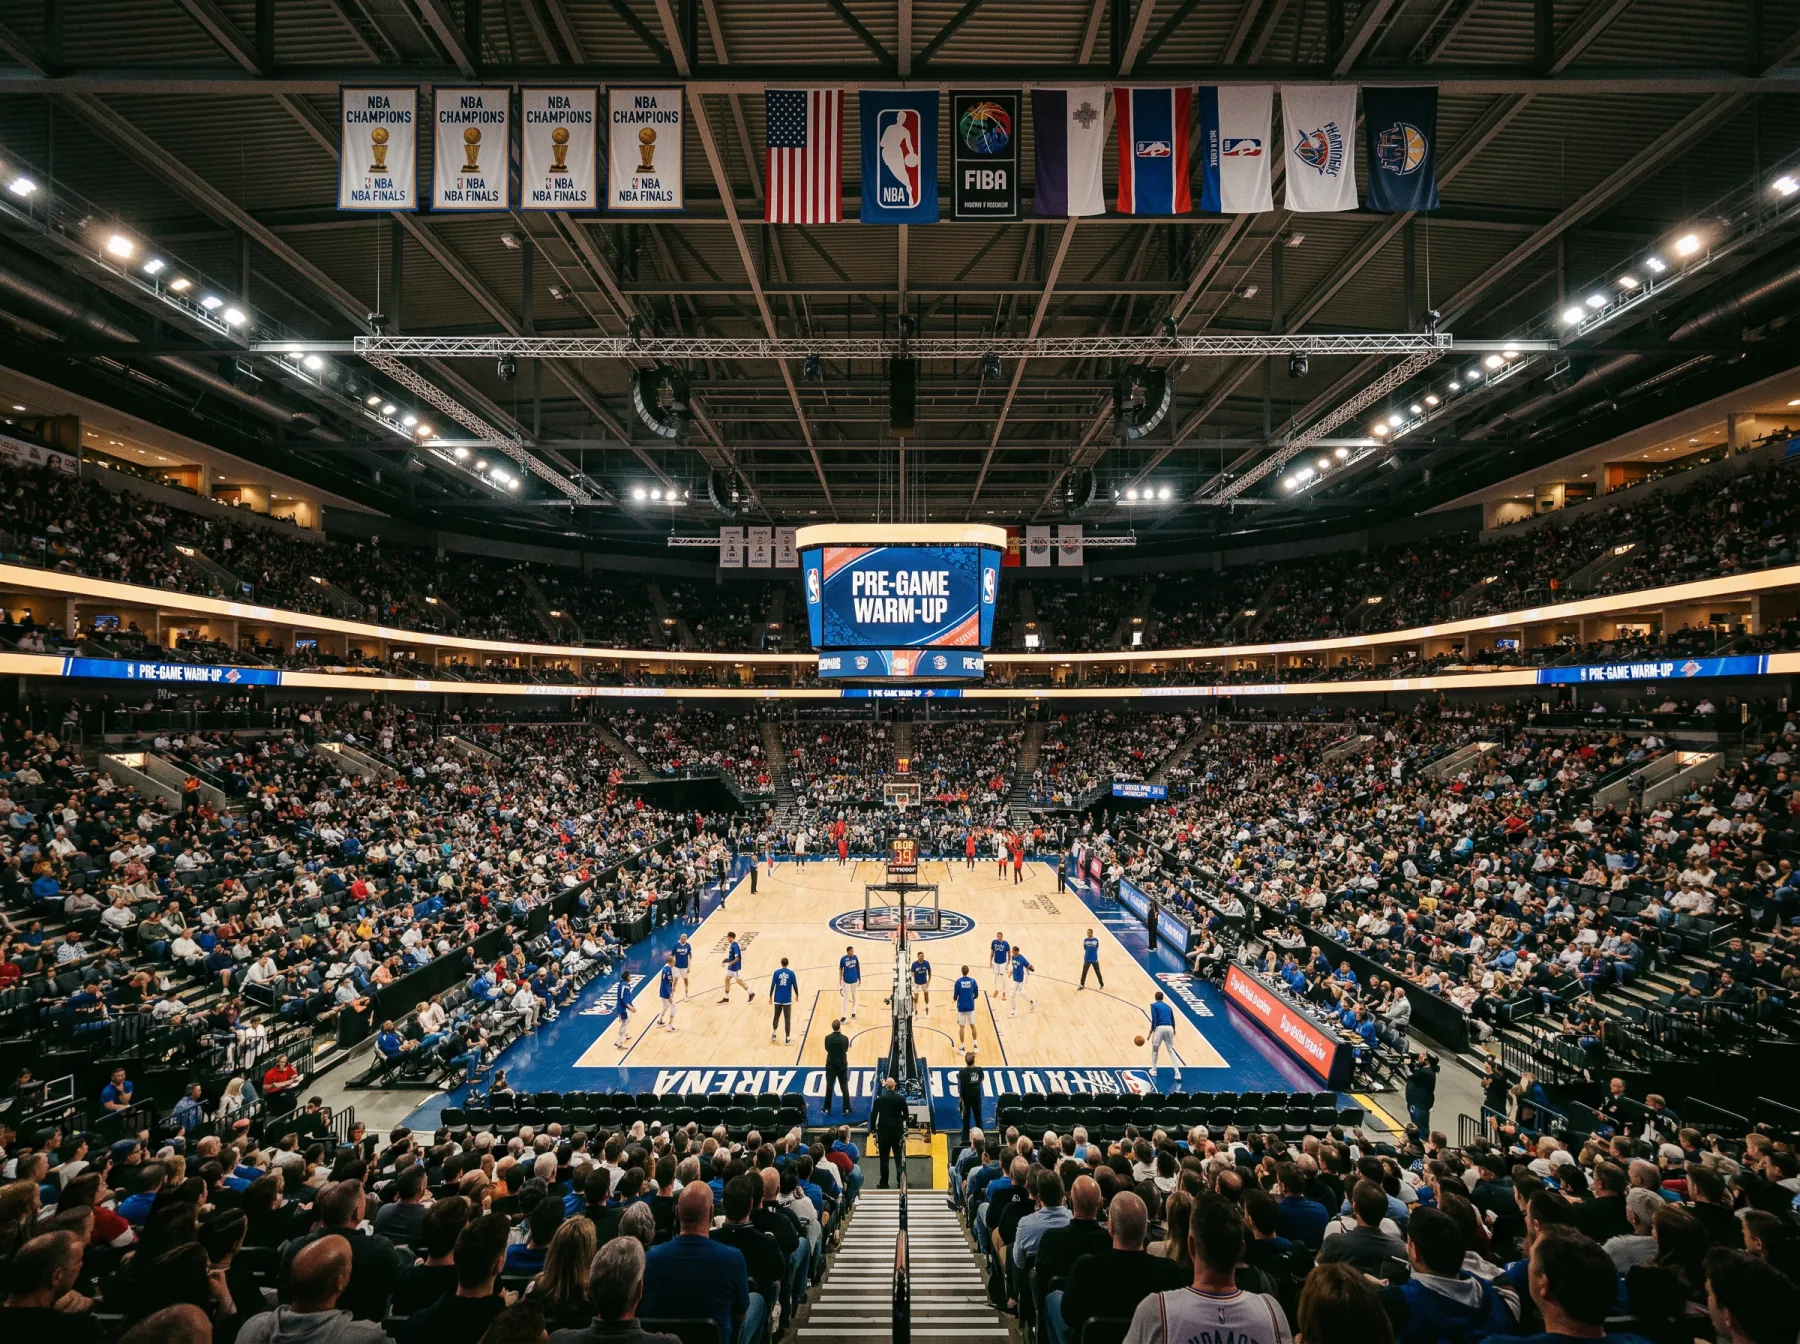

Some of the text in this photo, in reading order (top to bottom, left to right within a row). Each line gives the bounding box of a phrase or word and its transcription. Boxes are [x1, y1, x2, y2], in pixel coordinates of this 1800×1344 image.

[368, 96, 391, 109] NBA
[461, 96, 484, 109] NBA
[548, 96, 571, 109] NBA
[635, 96, 658, 109] NBA
[346, 110, 412, 124] CHAMPIONS
[439, 110, 505, 124] CHAMPIONS
[526, 110, 592, 124] CHAMPIONS
[613, 110, 679, 124] CHAMPIONS
[374, 177, 393, 189] NBA
[466, 177, 485, 189] NBA
[554, 177, 573, 189] NBA
[641, 178, 660, 189] NBA
[965, 169, 1007, 190] FIBA
[351, 190, 406, 201] NBA FINALS
[444, 190, 499, 201] NBA FINALS
[532, 190, 587, 201] NBA FINALS
[619, 190, 673, 201] NBA FINALS
[883, 187, 905, 202] NBA
[852, 570, 950, 596] PRE-GAME
[854, 597, 948, 623] WARM-UP
[139, 664, 222, 682] PRE-GAME WARM-UP
[1589, 663, 1673, 680] PRE-GAME WARM-UP
[652, 1070, 798, 1097] ARENA
